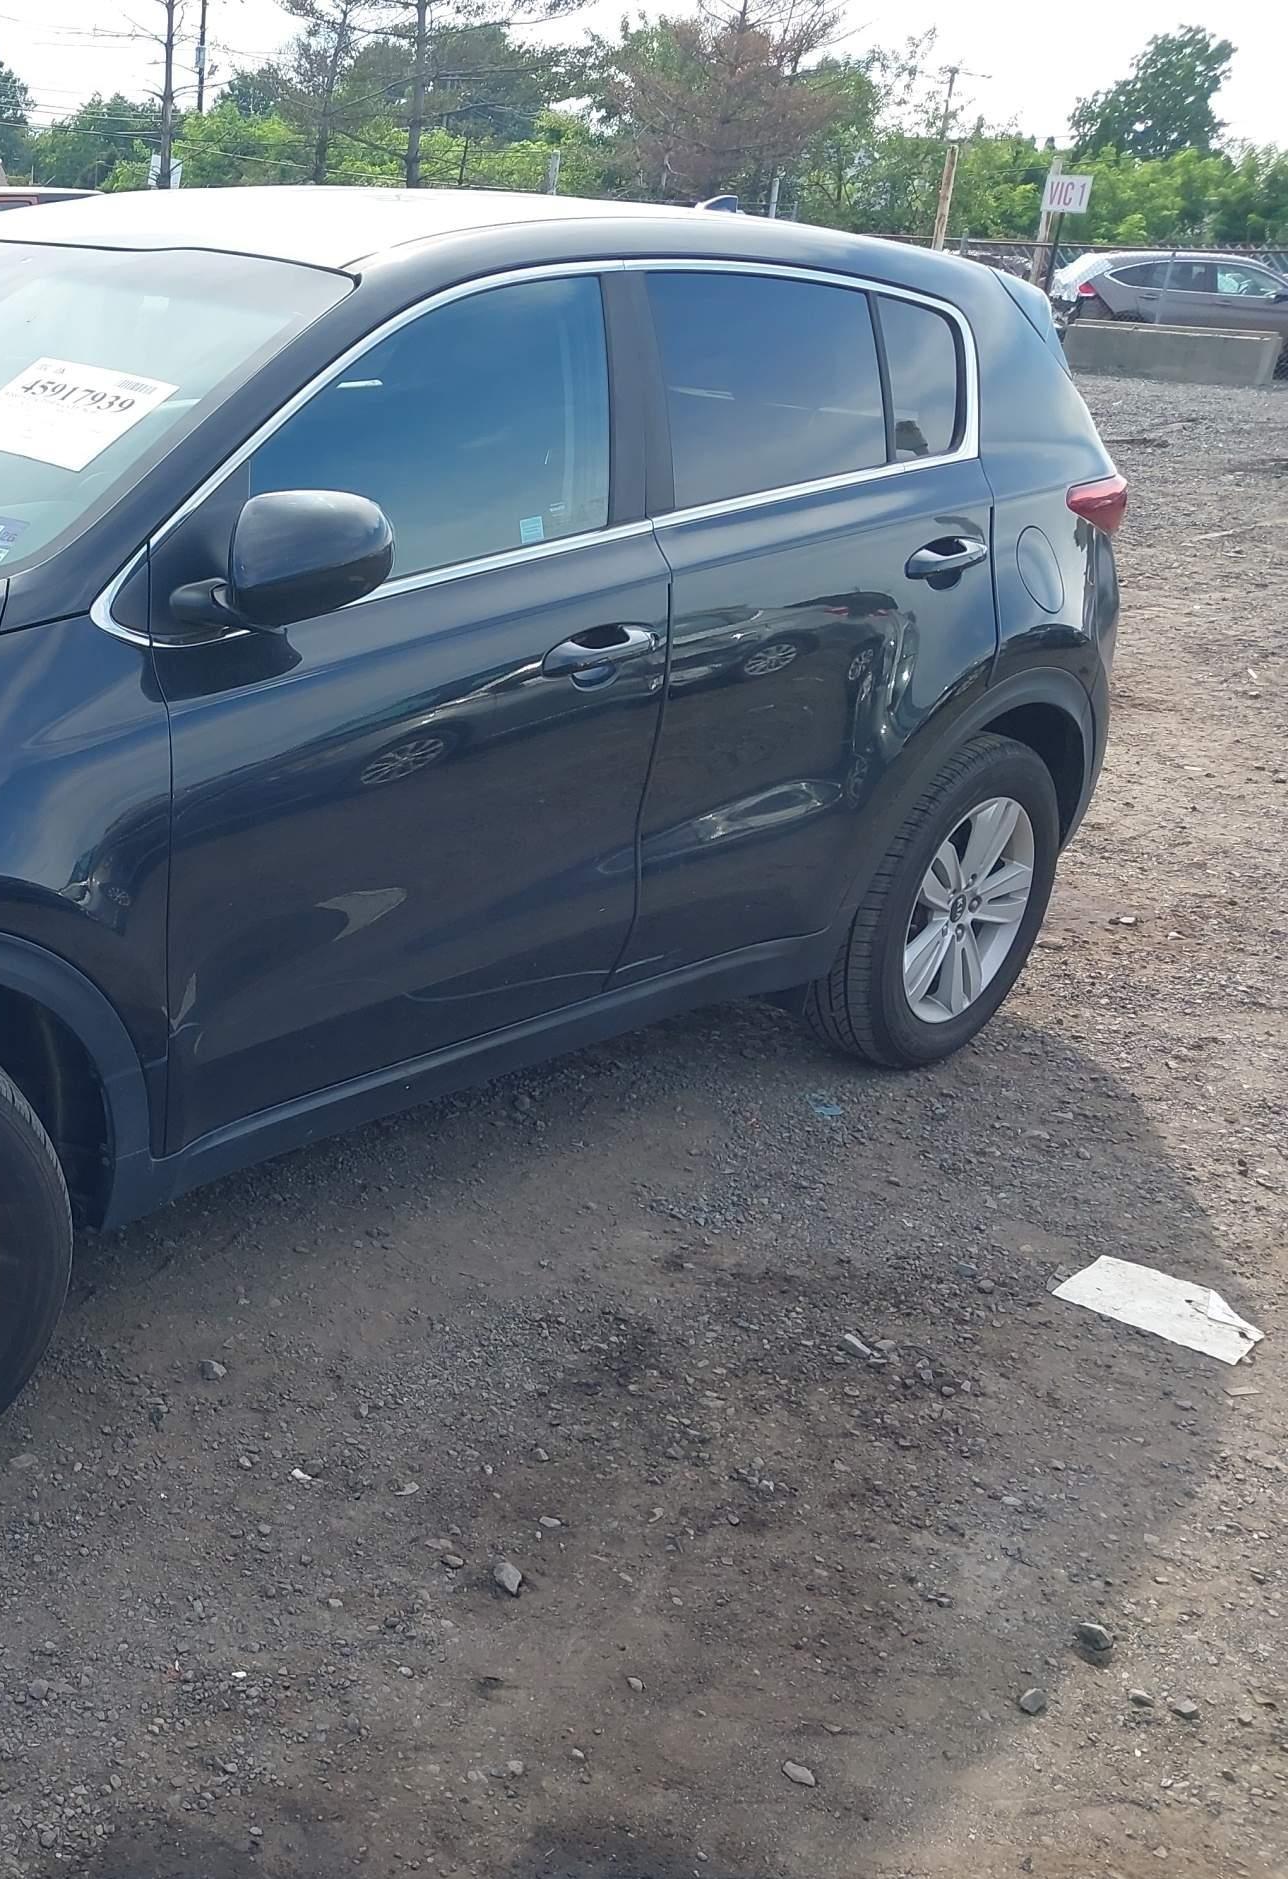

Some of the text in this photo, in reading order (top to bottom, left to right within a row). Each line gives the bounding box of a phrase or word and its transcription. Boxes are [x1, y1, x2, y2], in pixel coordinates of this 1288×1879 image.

[1049, 181, 1088, 207] VIC 1
[20, 379, 136, 413] 45917939
